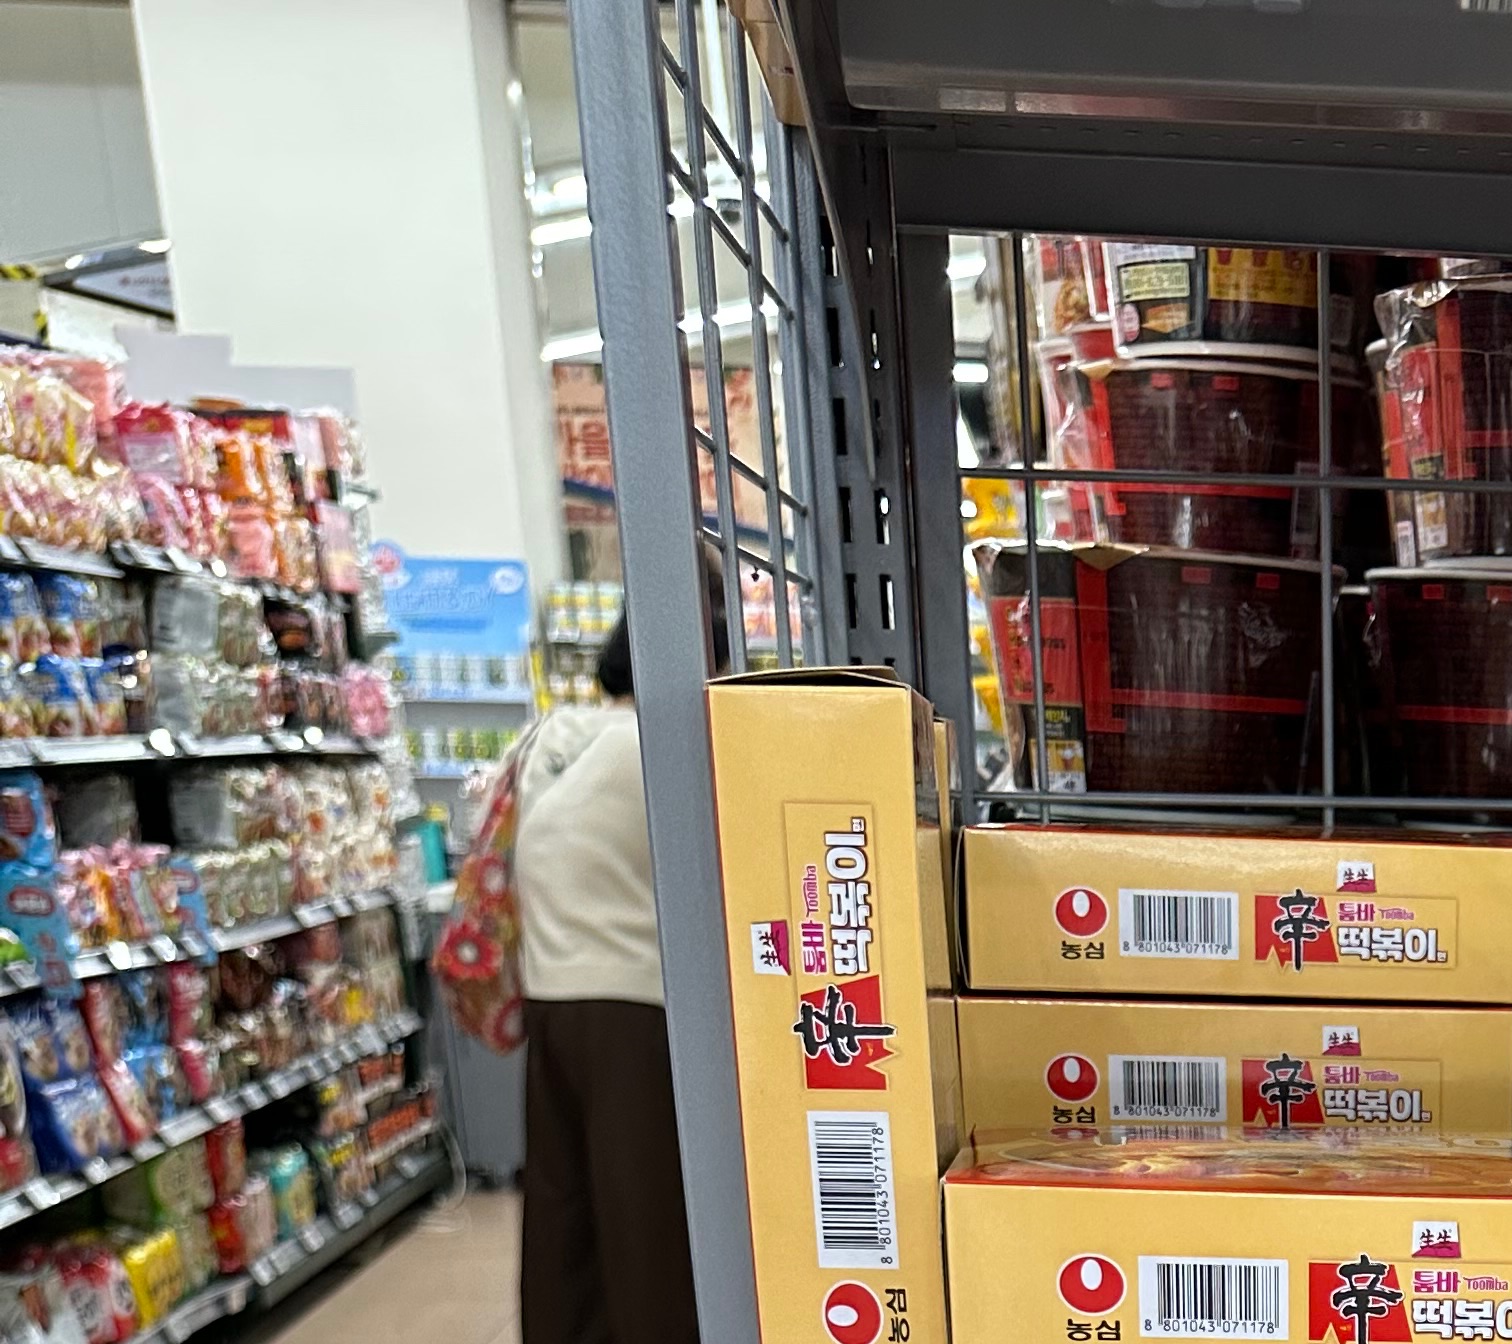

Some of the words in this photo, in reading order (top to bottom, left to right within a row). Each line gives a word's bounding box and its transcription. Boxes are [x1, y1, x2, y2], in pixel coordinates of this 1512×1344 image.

[1337, 902, 1376, 922] 툼바
[1273, 889, 1330, 971] 辛
[1060, 941, 1105, 960] 농심
[793, 984, 897, 1065] 辛
[1323, 1065, 1360, 1084] 툼바
[1259, 1053, 1316, 1128] 辛
[1052, 1105, 1097, 1124] 농심
[1413, 1270, 1461, 1293] 툼바
[1463, 1276, 1509, 1292] Toomba
[888, 1287, 910, 1343] 농심
[1162, 1319, 1217, 1333] 801043
[1222, 1320, 1278, 1334] 071178
[1066, 1318, 1122, 1341] 농심
